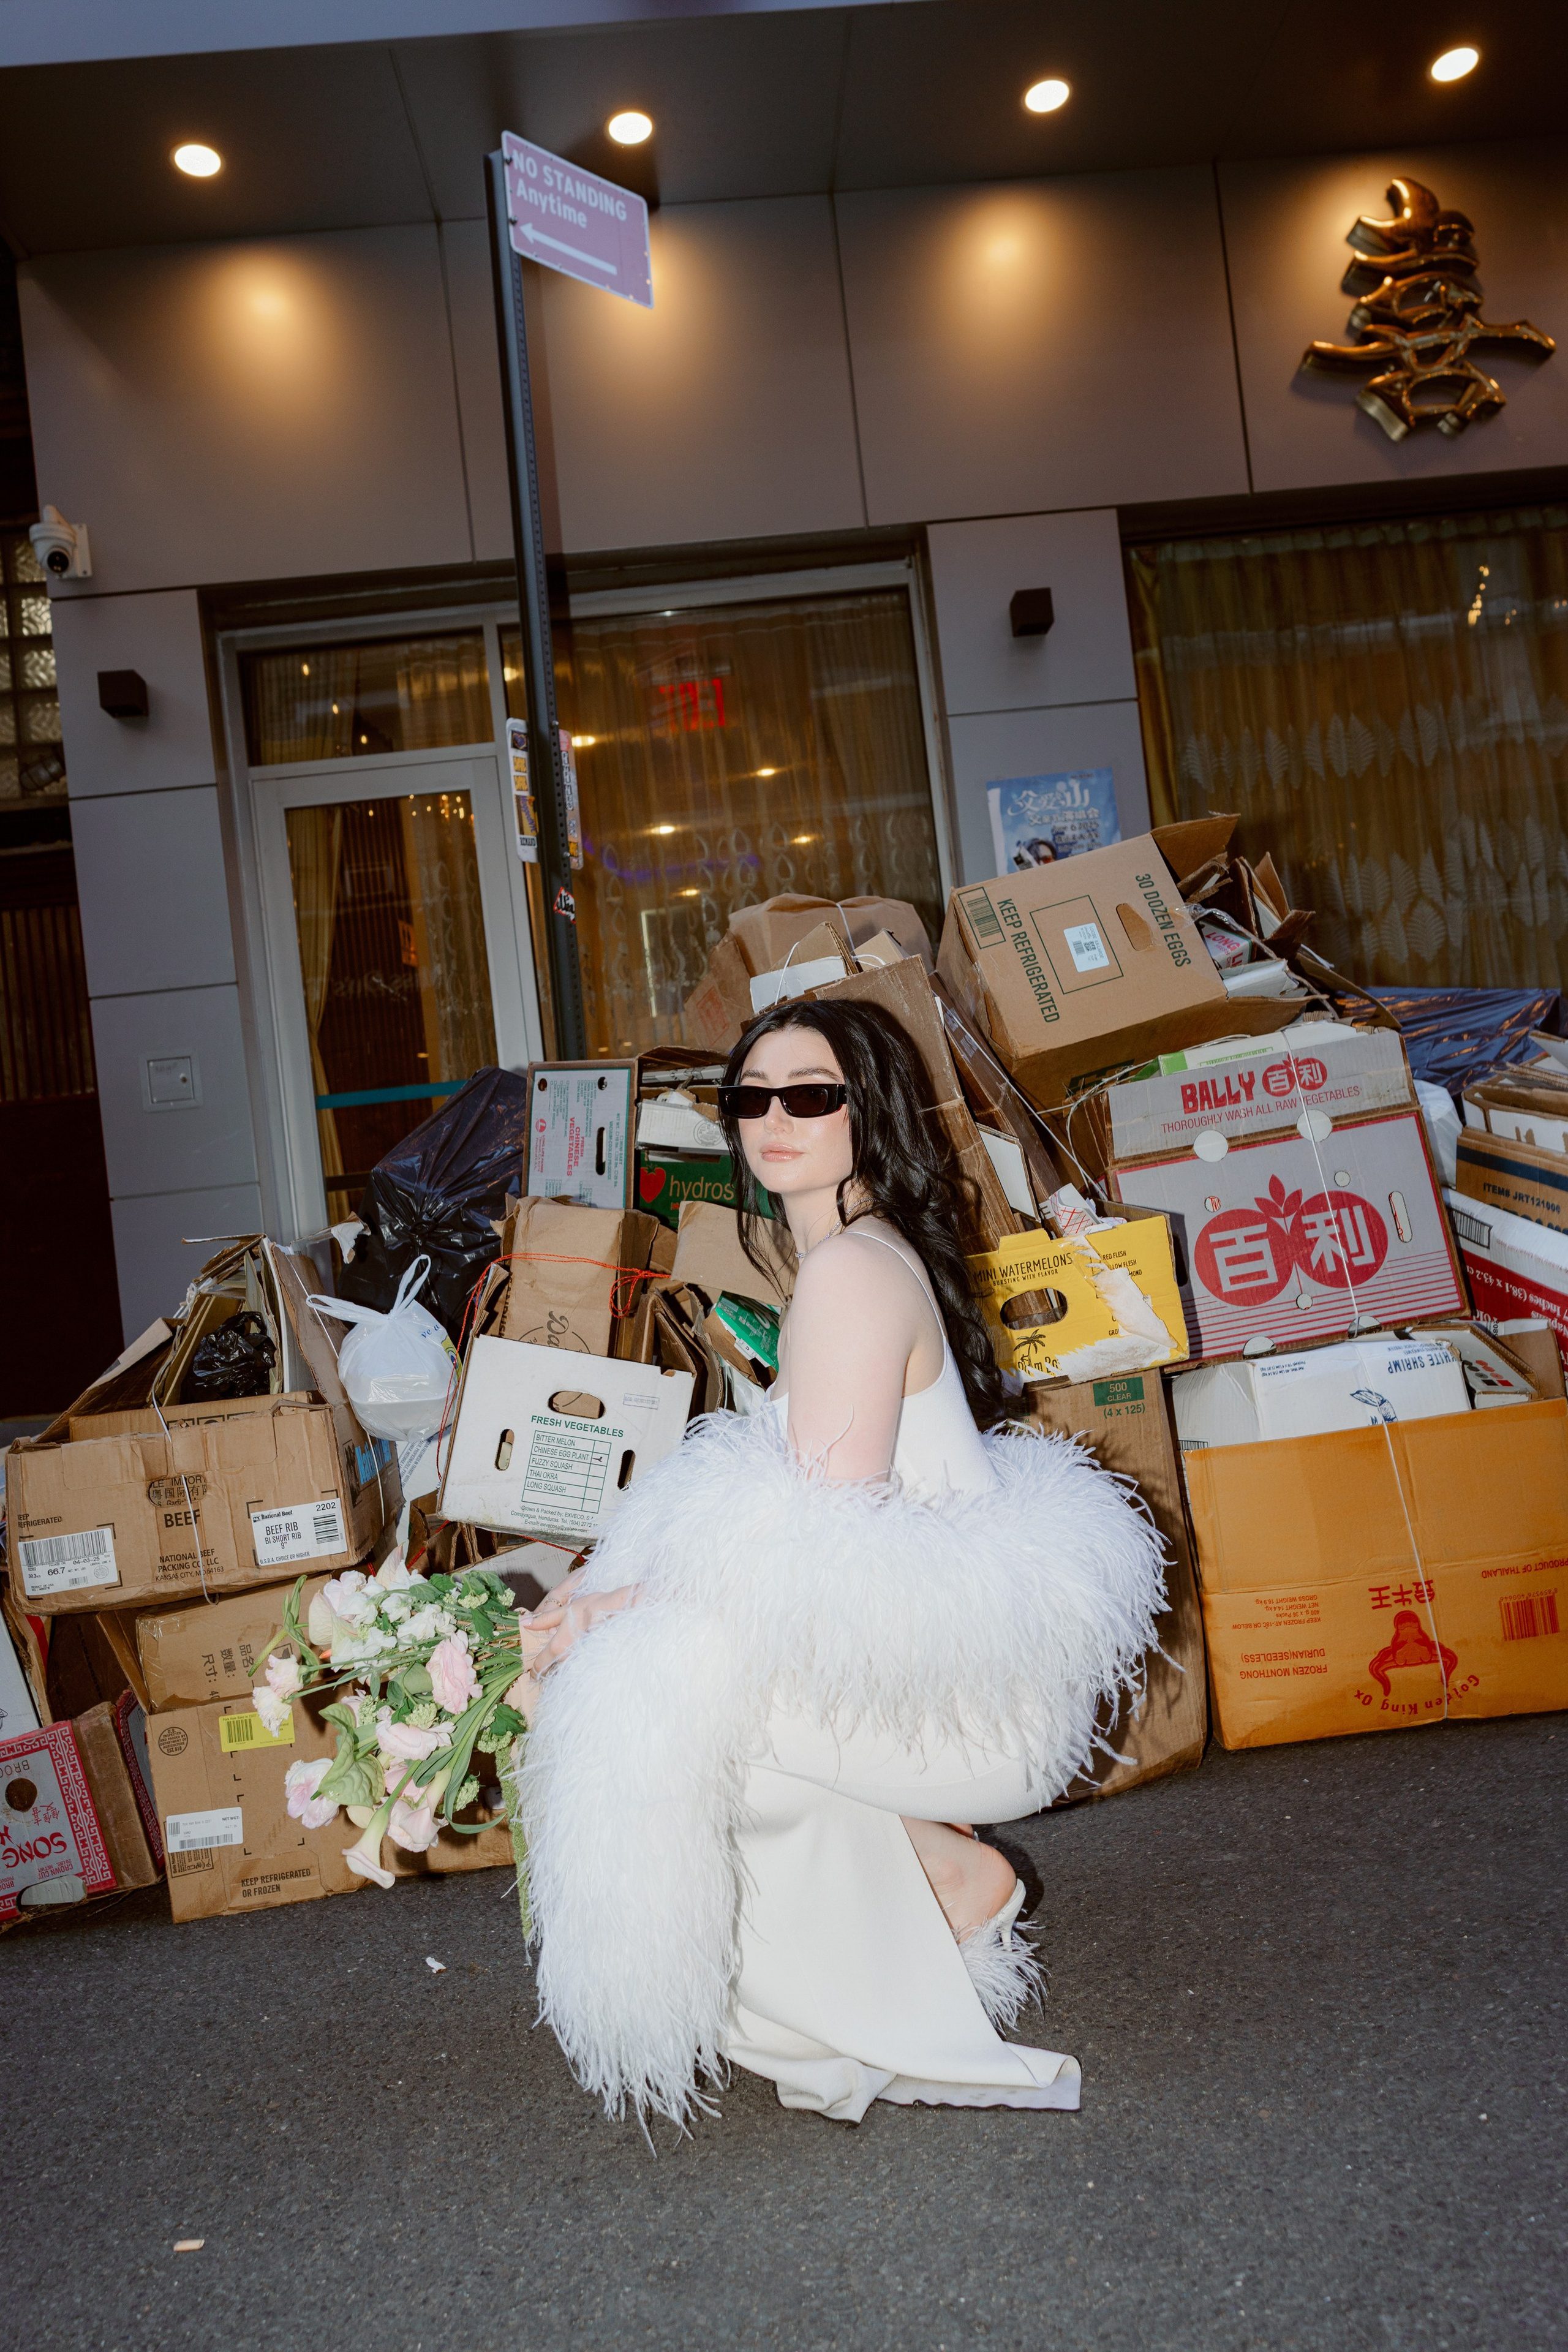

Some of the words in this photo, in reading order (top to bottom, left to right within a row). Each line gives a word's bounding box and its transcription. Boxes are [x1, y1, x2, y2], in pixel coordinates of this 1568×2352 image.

[513, 149, 538, 179] NO
[543, 164, 627, 221] STANDING
[517, 178, 587, 228] Anytime
[1134, 870, 1155, 891] 30
[1143, 888, 1175, 933] DOZEN
[1204, 929, 1241, 952] LONG
[1163, 930, 1191, 969] EGGS
[997, 897, 1023, 932] KEEP
[1010, 929, 1061, 1025] REFRIGERATED
[1178, 1070, 1259, 1114] BALLY
[1161, 1112, 1224, 1134] THOROUGHLY
[1224, 1106, 1254, 1121] WASH
[1254, 1102, 1273, 1115] ALL
[1275, 1098, 1297, 1111] RAW
[1298, 1085, 1360, 1106] VEGETABLES
[669, 1174, 735, 1205] hydros
[1482, 1182, 1510, 1197] ITEM#
[1210, 1205, 1374, 1292] 百利
[998, 1253, 1073, 1278] WATERMELONS
[992, 1276, 1020, 1286] BURSTING
[1038, 1268, 1058, 1277] FLAVOR
[1473, 1269, 1494, 1286] 43.2
[1494, 1278, 1502, 1287] x
[1502, 1282, 1528, 1301] (38.1
[1526, 1292, 1562, 1316] Inches
[1386, 1354, 1425, 1374] SHRIMP
[1109, 1381, 1127, 1393] 500
[1107, 1392, 1131, 1401] CLEAR
[1102, 1407, 1113, 1419] (4
[1124, 1402, 1145, 1415] 125)
[530, 1414, 562, 1427] FRESH
[564, 1420, 624, 1438] VEGETABLES
[536, 1433, 556, 1443] BITTER
[557, 1437, 576, 1447] MELON
[533, 1445, 557, 1456] CHINESE
[558, 1449, 571, 1458] EGG
[571, 1452, 590, 1461] PLANT
[531, 1457, 551, 1467] FUZZY
[551, 1460, 573, 1470] SQUASH
[529, 1469, 542, 1477] THAI
[542, 1471, 559, 1480] OKRA
[526, 1480, 543, 1490] LONG
[543, 1483, 566, 1493] SQUASH
[164, 1509, 201, 1528] BEEF
[261, 1511, 281, 1520] National
[315, 1501, 336, 1512] 2202
[510, 1509, 537, 1520] Comayagua,
[538, 1514, 559, 1523] Honduras.
[564, 1512, 586, 1521] EXVECO,
[265, 1524, 283, 1535] BEEF
[285, 1521, 298, 1532] RIB
[272, 1533, 290, 1543] SHORT
[72, 1556, 100, 1565] 04-03-25
[159, 1552, 197, 1563] NATIONAL
[200, 1548, 215, 1558] BEEF
[47, 1567, 66, 1576] 66.7
[157, 1562, 190, 1572] PACKING
[206, 1557, 219, 1566] LLC
[1480, 1566, 1520, 1578] THAILAND
[1521, 1564, 1532, 1573] OF
[1533, 1558, 1568, 1571] PRODUCT
[155, 1572, 178, 1581] KANSAS
[1499, 1593, 1525, 1602] 400646
[1527, 1589, 1551, 1597] 859376
[1240, 1645, 1325, 1664] DURIAN(SEEDLESS)
[1239, 1667, 1289, 1679] MONTHONG
[1292, 1664, 1327, 1675] FROZEN
[1353, 1689, 1372, 1706] Ox
[1424, 1674, 1479, 1709] Golden
[1380, 1698, 1417, 1715] King
[0, 1831, 69, 1869] SONG
[37, 1870, 50, 1879] CUT
[49, 1863, 74, 1875] CROWN
[241, 1877, 258, 1887] KEEP
[260, 1868, 311, 1883] REFRIGERATED
[242, 1888, 252, 1898] OR
[253, 1883, 281, 1896] FROZEN
